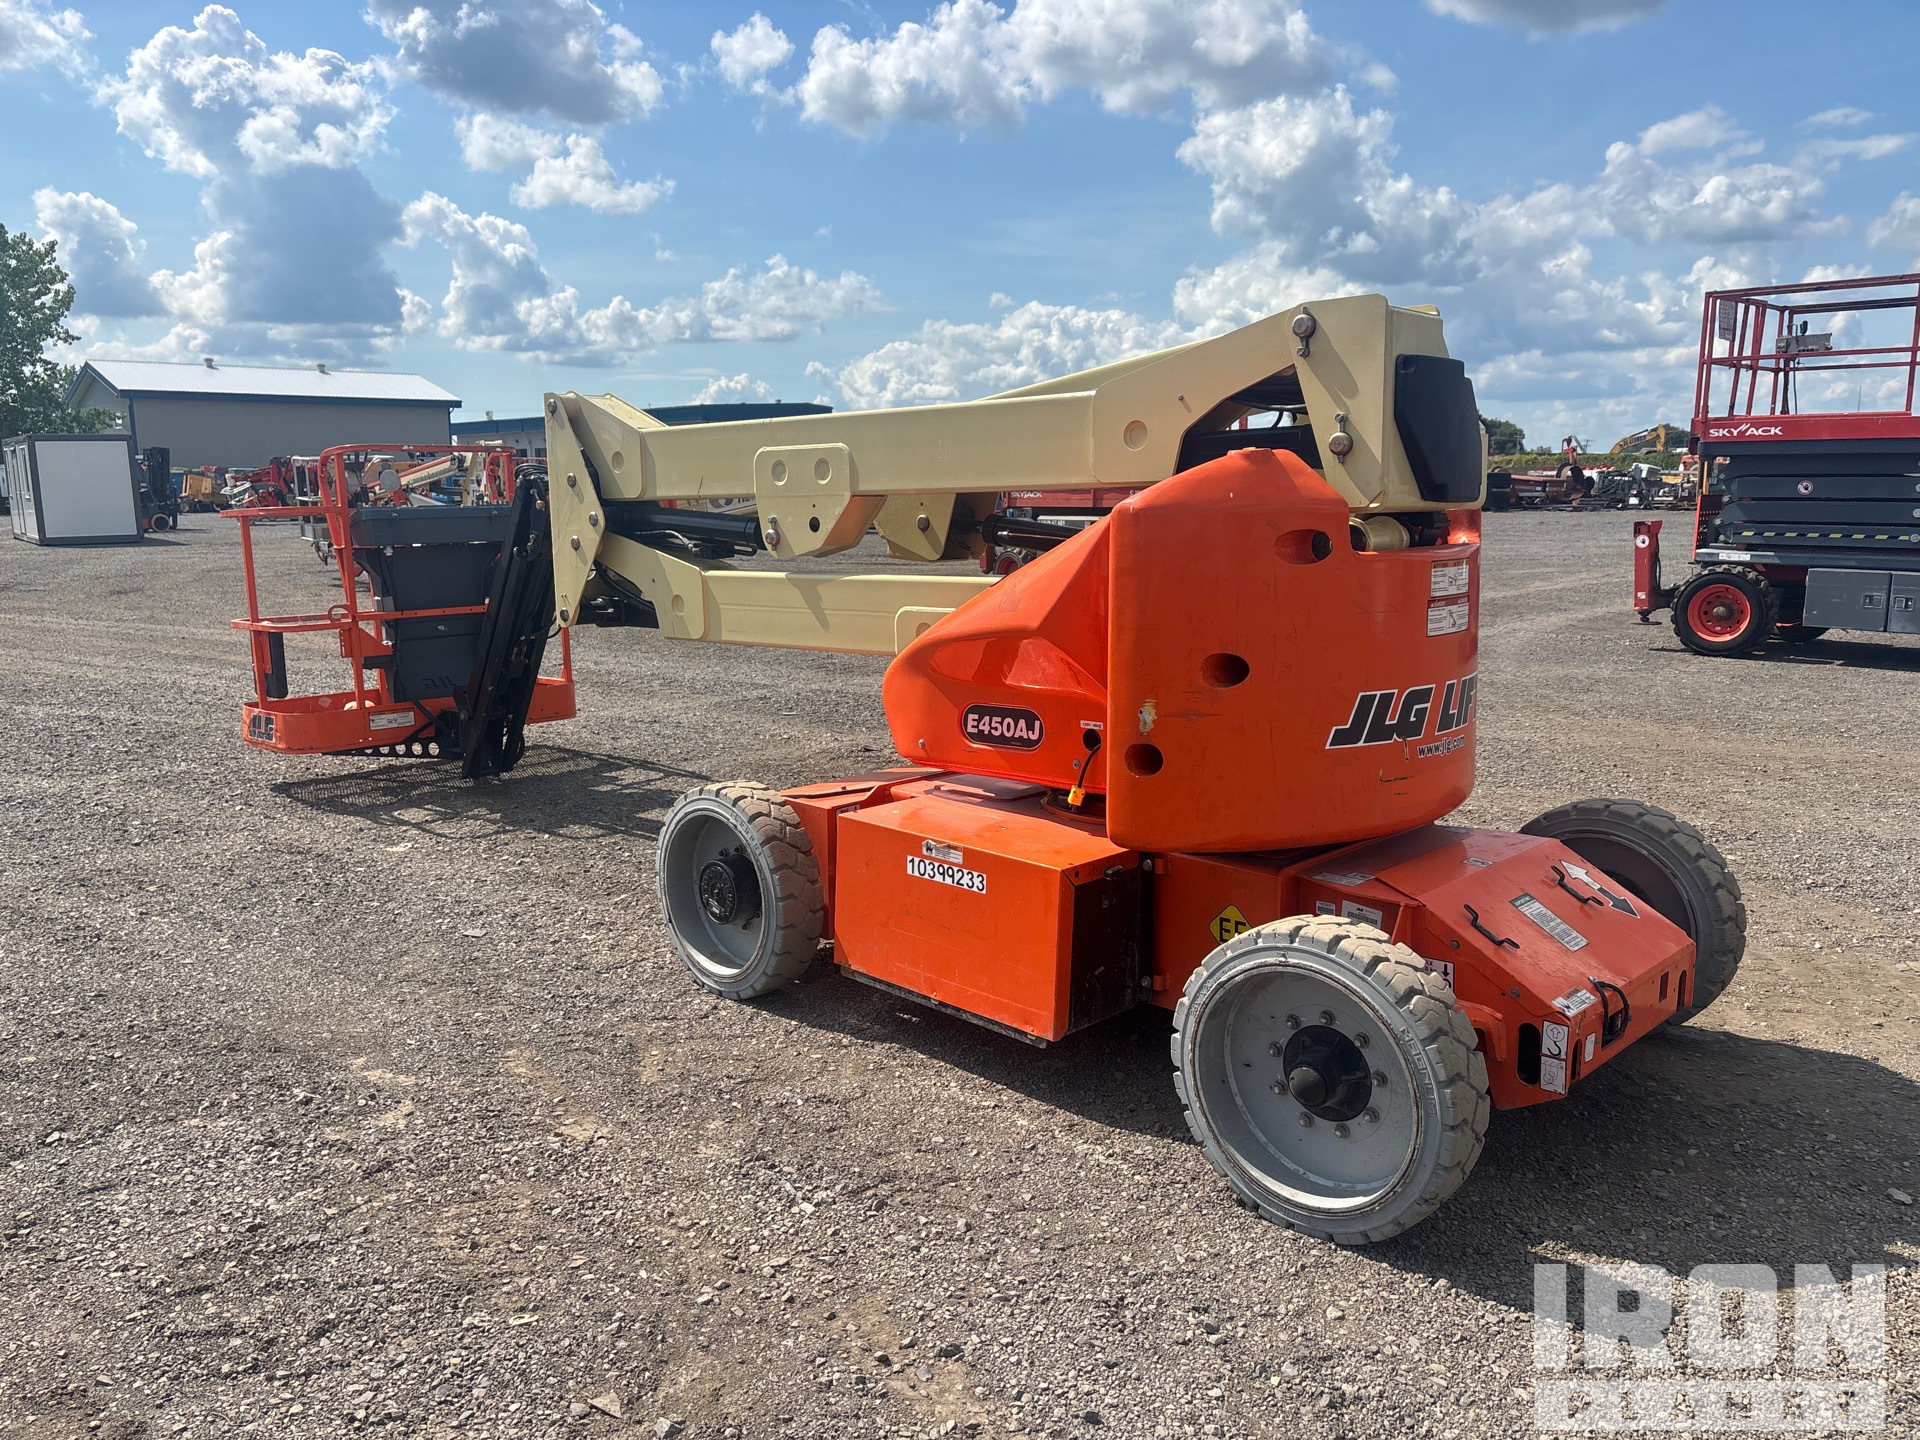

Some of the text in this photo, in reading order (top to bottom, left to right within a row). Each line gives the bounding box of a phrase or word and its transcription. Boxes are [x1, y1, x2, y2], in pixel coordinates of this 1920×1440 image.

[1010, 490, 1043, 498] SKYJACK
[1325, 671, 1478, 749] JLG LIF
[249, 713, 275, 742] JLG
[966, 713, 1041, 741] E450AJ
[1417, 735, 1465, 758] www.jlg.com
[908, 857, 985, 892] 10399233
[1399, 1026, 1437, 1115] MAGNUM
